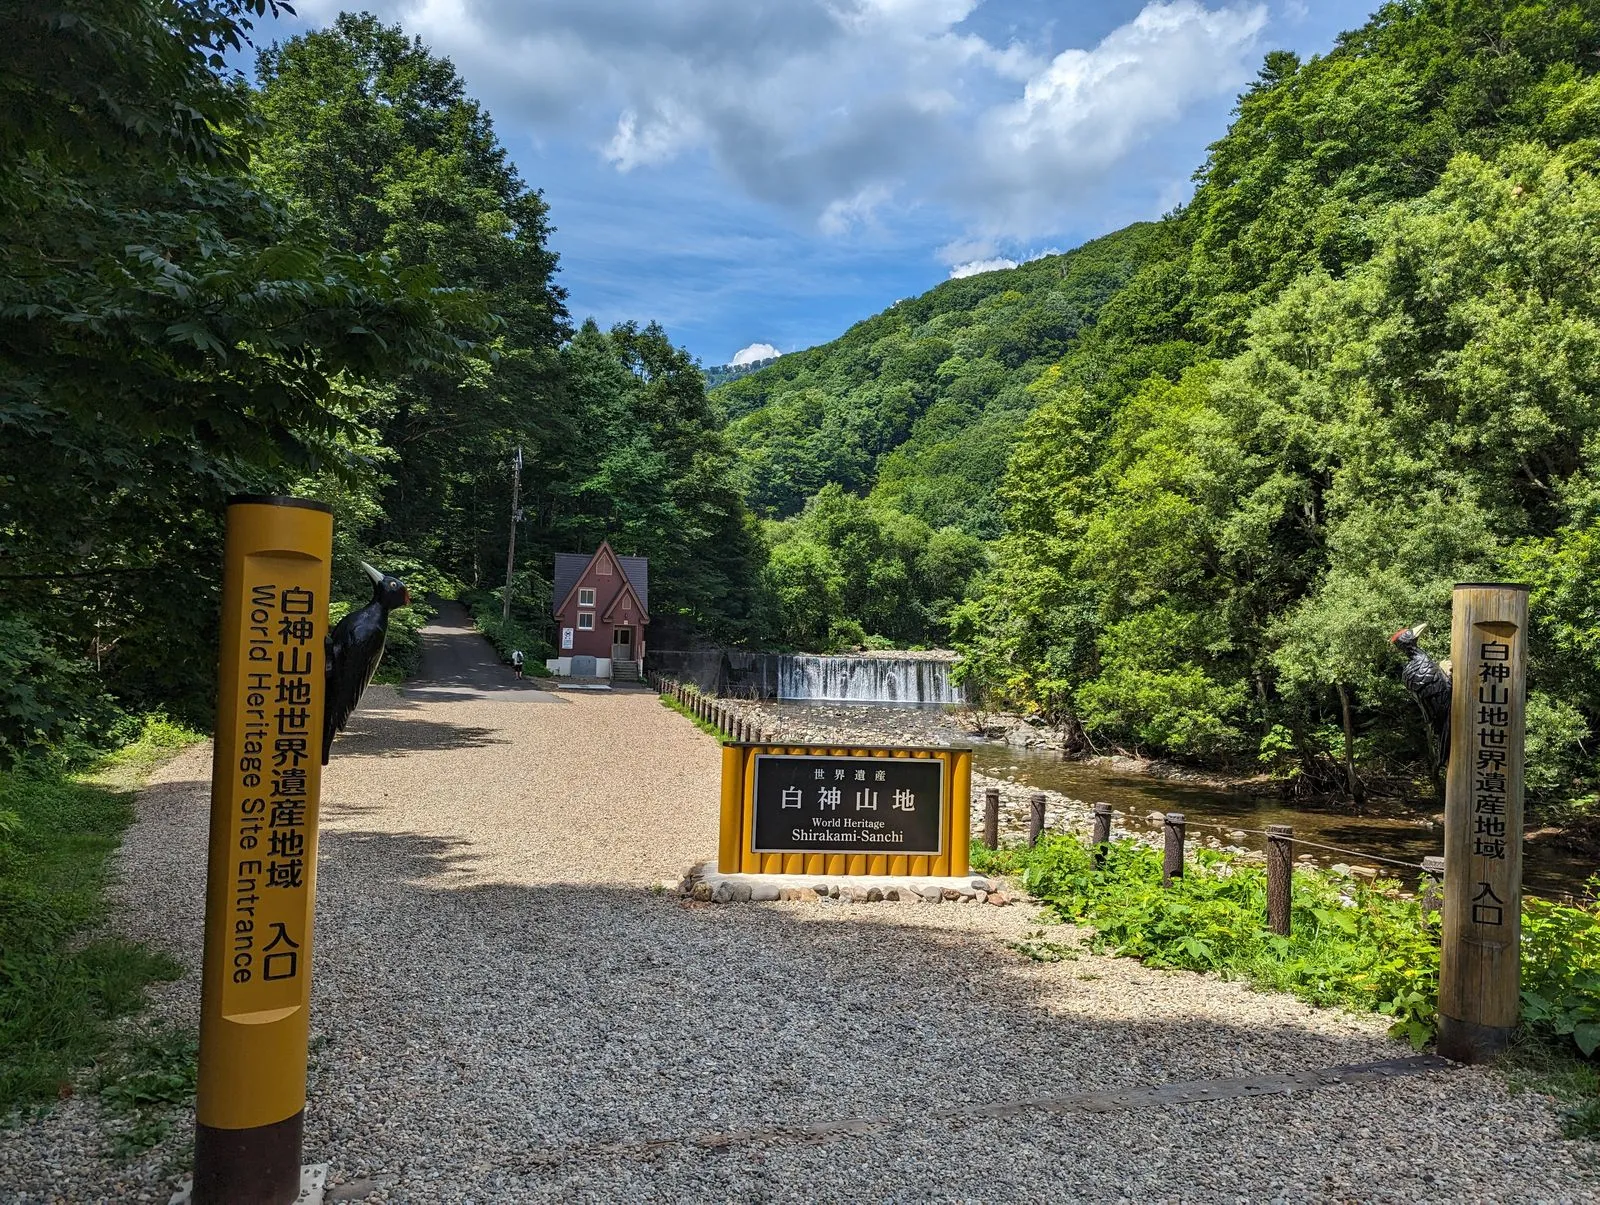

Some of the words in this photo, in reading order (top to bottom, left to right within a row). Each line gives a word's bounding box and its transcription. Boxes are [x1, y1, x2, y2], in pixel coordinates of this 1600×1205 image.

[248, 584, 276, 663] World
[240, 672, 271, 788] Heritage
[264, 586, 314, 889] 白神山地世界遺産地域
[1472, 640, 1510, 860] 白神山地世界遺産地域
[780, 786, 916, 812] 白神山地
[814, 768, 886, 782] 世界遺産
[240, 798, 266, 850] Site
[791, 828, 904, 843] Shirakami-Sanchi
[812, 817, 842, 828] World
[844, 818, 886, 829] Heritage
[232, 860, 262, 985] Entrance
[1472, 882, 1504, 926] 入口
[262, 922, 299, 982] 入口
